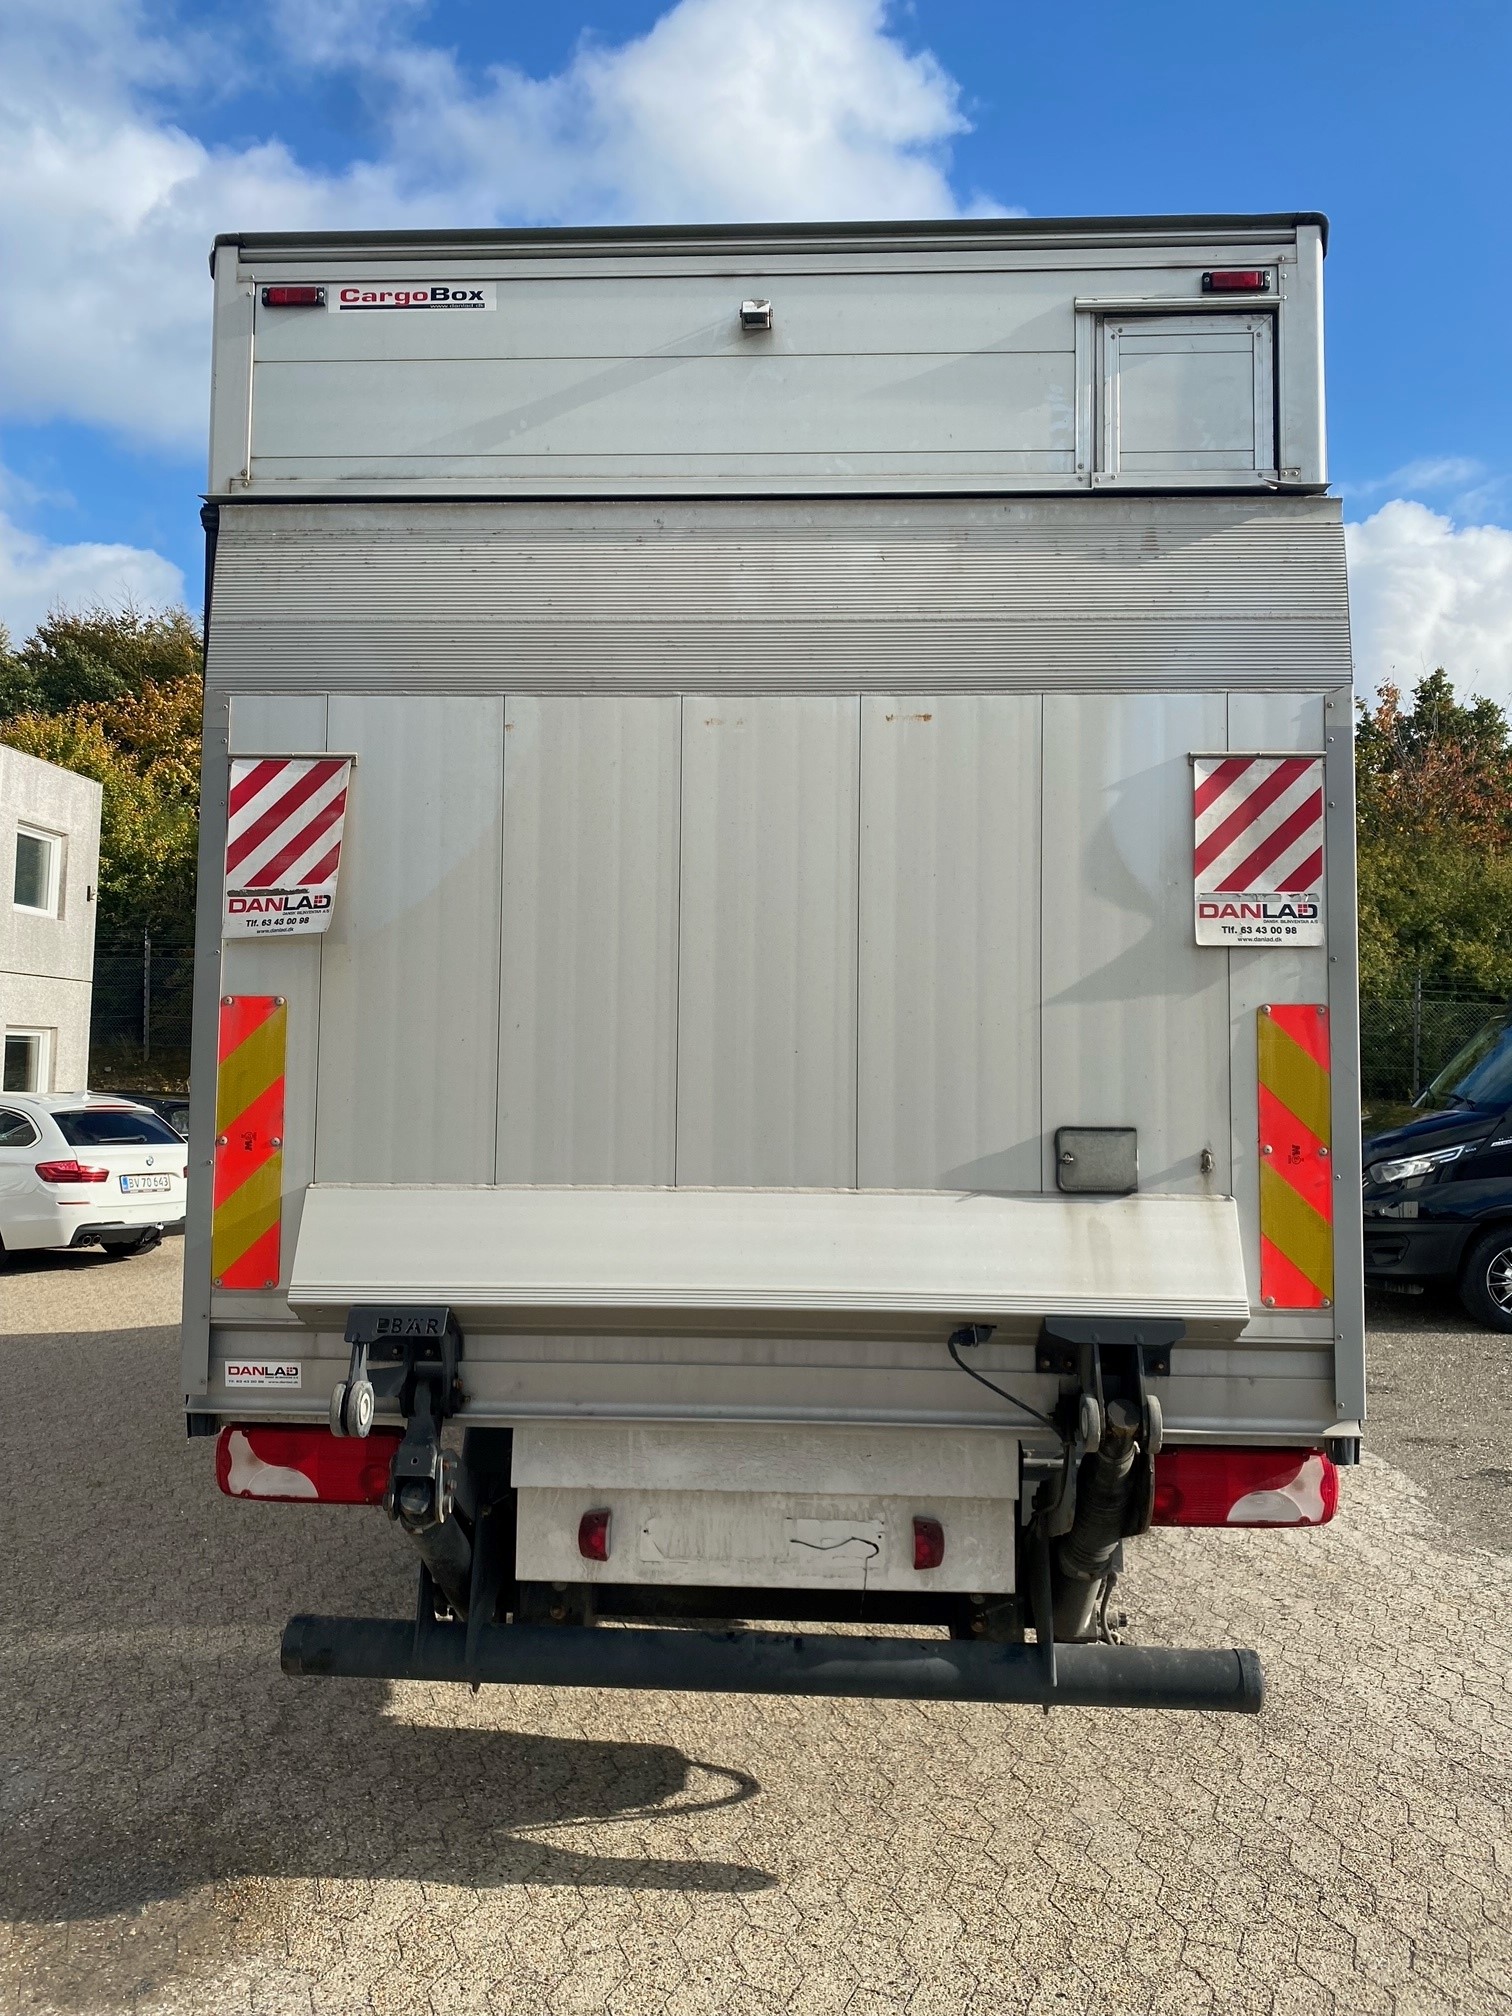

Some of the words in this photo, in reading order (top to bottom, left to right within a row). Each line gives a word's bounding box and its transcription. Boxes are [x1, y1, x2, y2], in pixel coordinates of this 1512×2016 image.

[340, 287, 484, 306] CargoBox
[228, 894, 331, 913] DANLAD
[1199, 903, 1318, 919] DANLAD
[246, 919, 259, 927] Tlf.
[261, 918, 271, 927] 63
[274, 918, 284, 926] 43
[286, 917, 297, 925] 00
[299, 916, 310, 924] 98
[1222, 926, 1238, 934] Tlf.
[1241, 926, 1252, 934] 63
[1256, 926, 1267, 934] 43
[1271, 926, 1282, 934] 00
[1285, 926, 1297, 934] 98
[129, 1178, 140, 1188] BV
[142, 1177, 152, 1187] 70
[154, 1176, 169, 1187] 643
[228, 1366, 298, 1376] DANLAD
